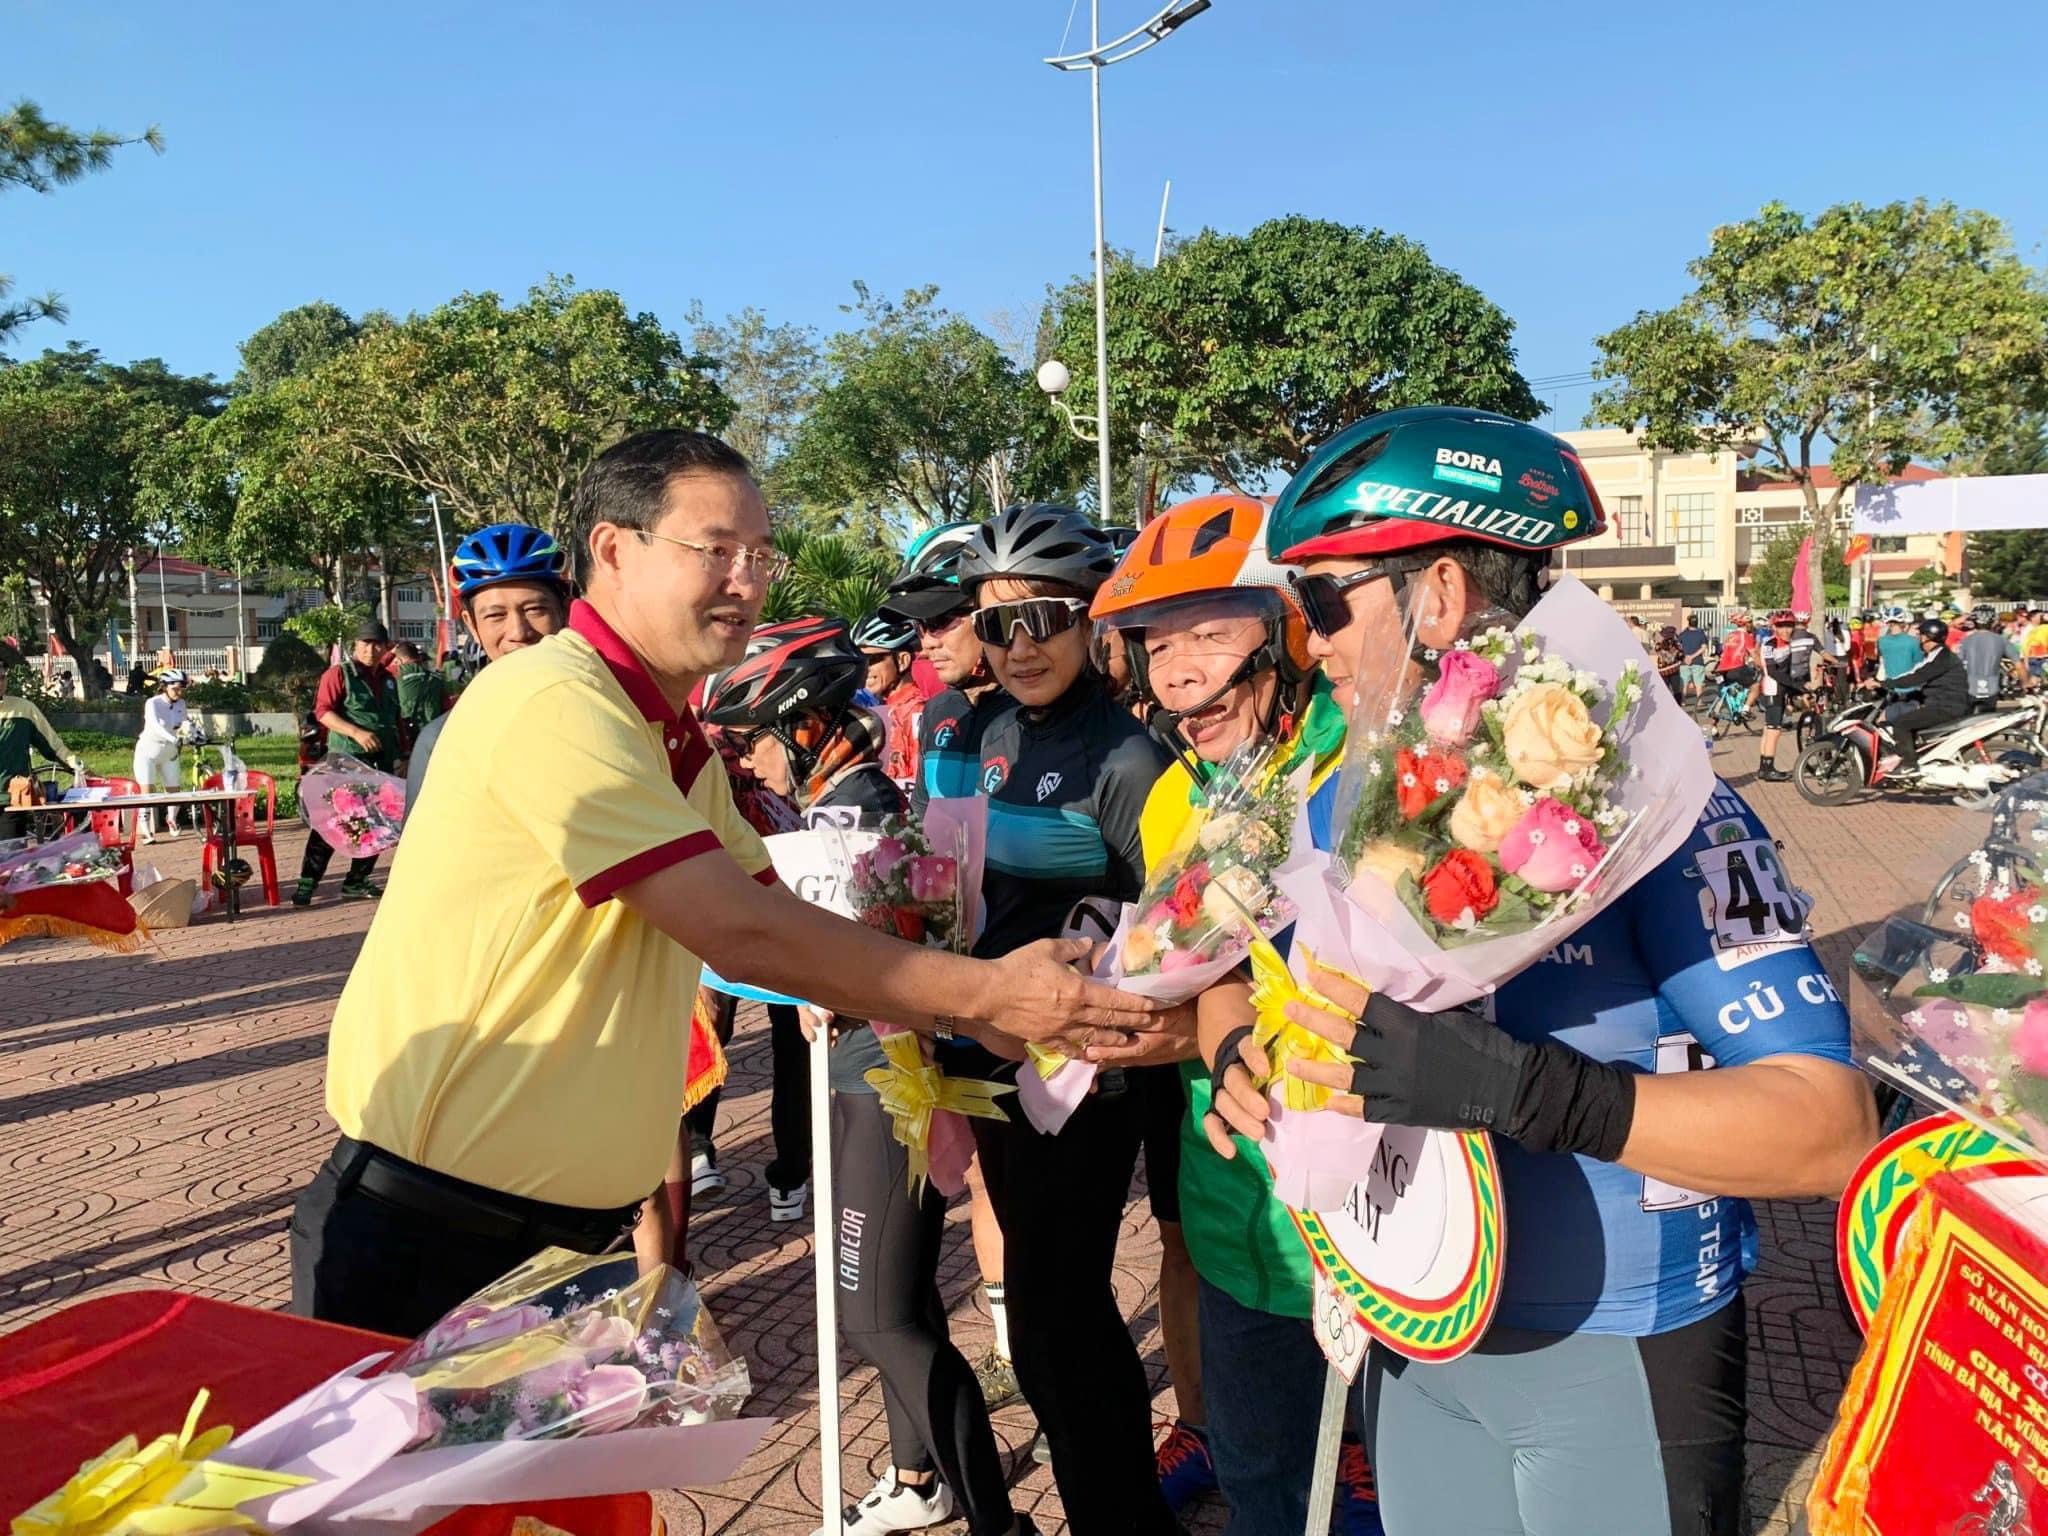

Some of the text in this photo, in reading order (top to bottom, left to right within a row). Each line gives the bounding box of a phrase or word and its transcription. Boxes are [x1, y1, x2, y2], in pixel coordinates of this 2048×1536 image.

[1436, 448, 1503, 476] BORA
[1346, 481, 1555, 544] SPECIALIZED
[1725, 845, 1803, 935] 43
[1718, 981, 1785, 1034] CỦ
[1695, 1221, 1721, 1303] TEAM
[1960, 1263, 1985, 1289] SỞ
[2021, 1313, 2048, 1347] HO
[1976, 1408, 2022, 1457] NĂM
